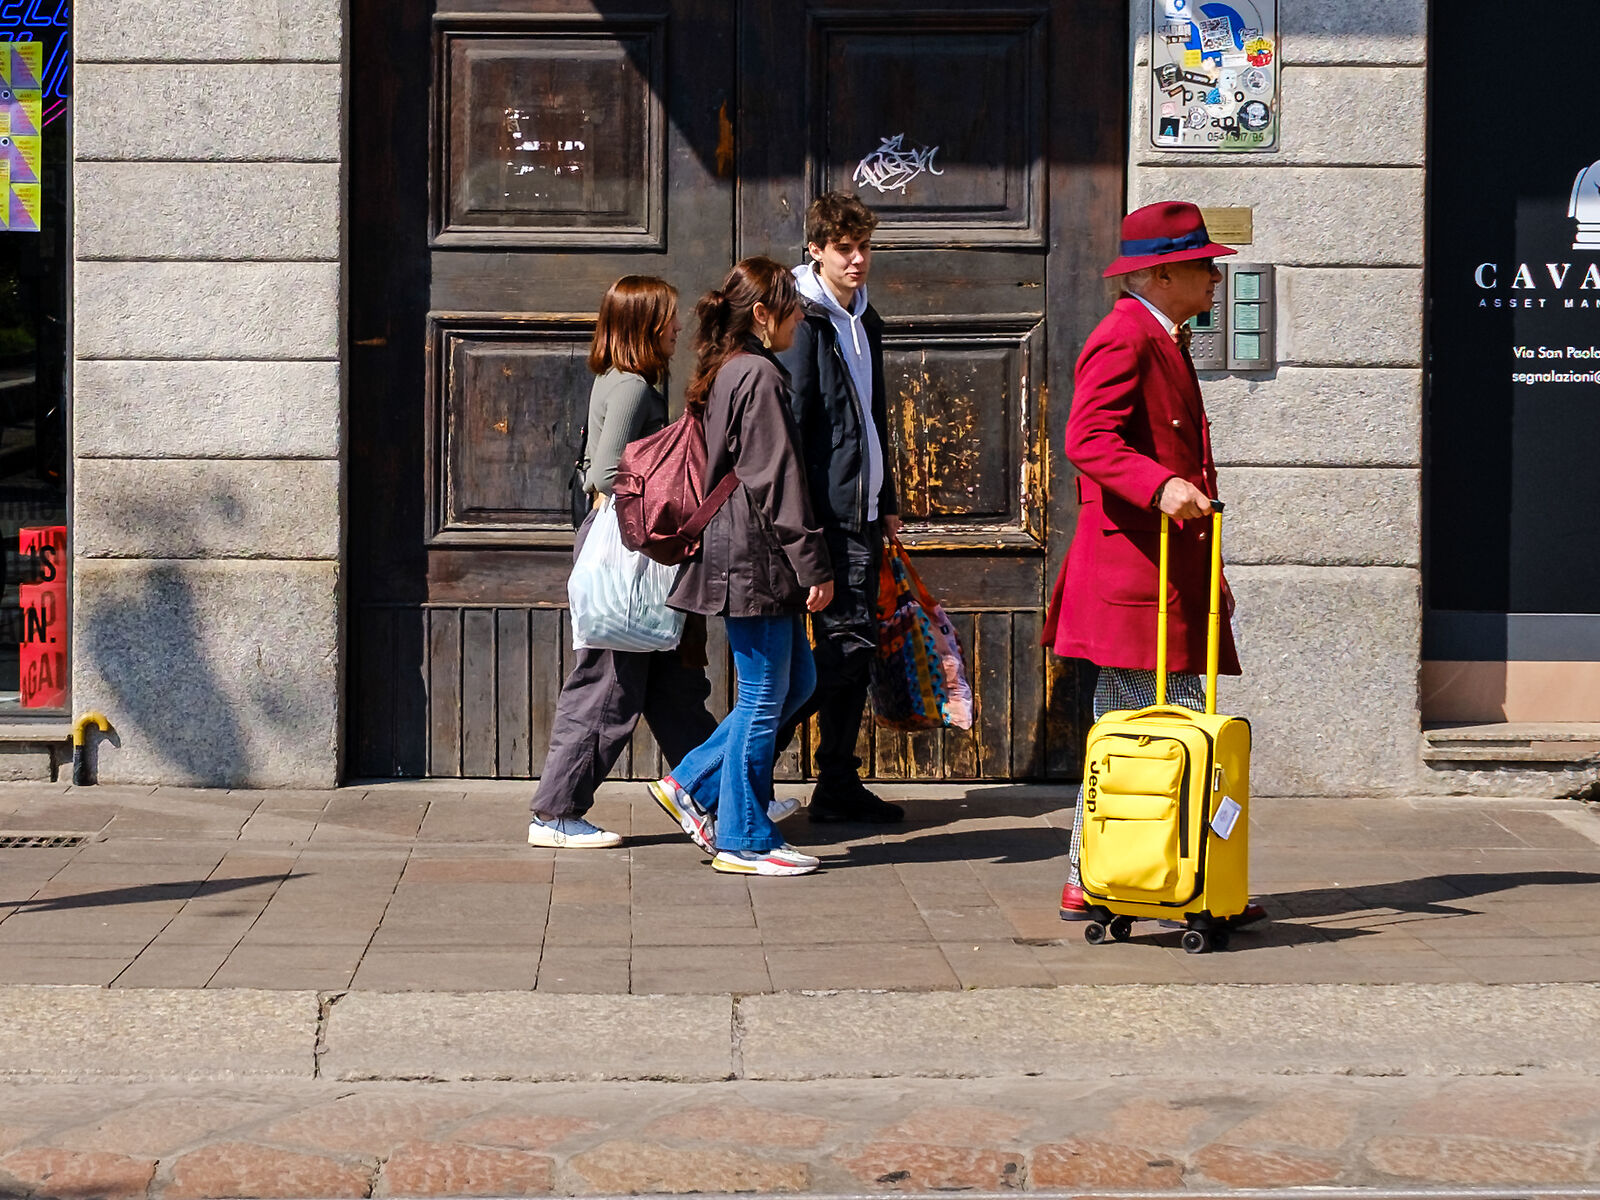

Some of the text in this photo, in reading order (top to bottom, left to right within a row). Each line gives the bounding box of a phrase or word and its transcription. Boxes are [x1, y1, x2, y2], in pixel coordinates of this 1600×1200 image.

[1182, 90, 1245, 106] pao
[1474, 262, 1600, 290] CAVA
[1478, 298, 1546, 308] ASSET
[1513, 346, 1535, 358] Via
[1538, 346, 1563, 358] San
[1086, 760, 1100, 813] Jeep
